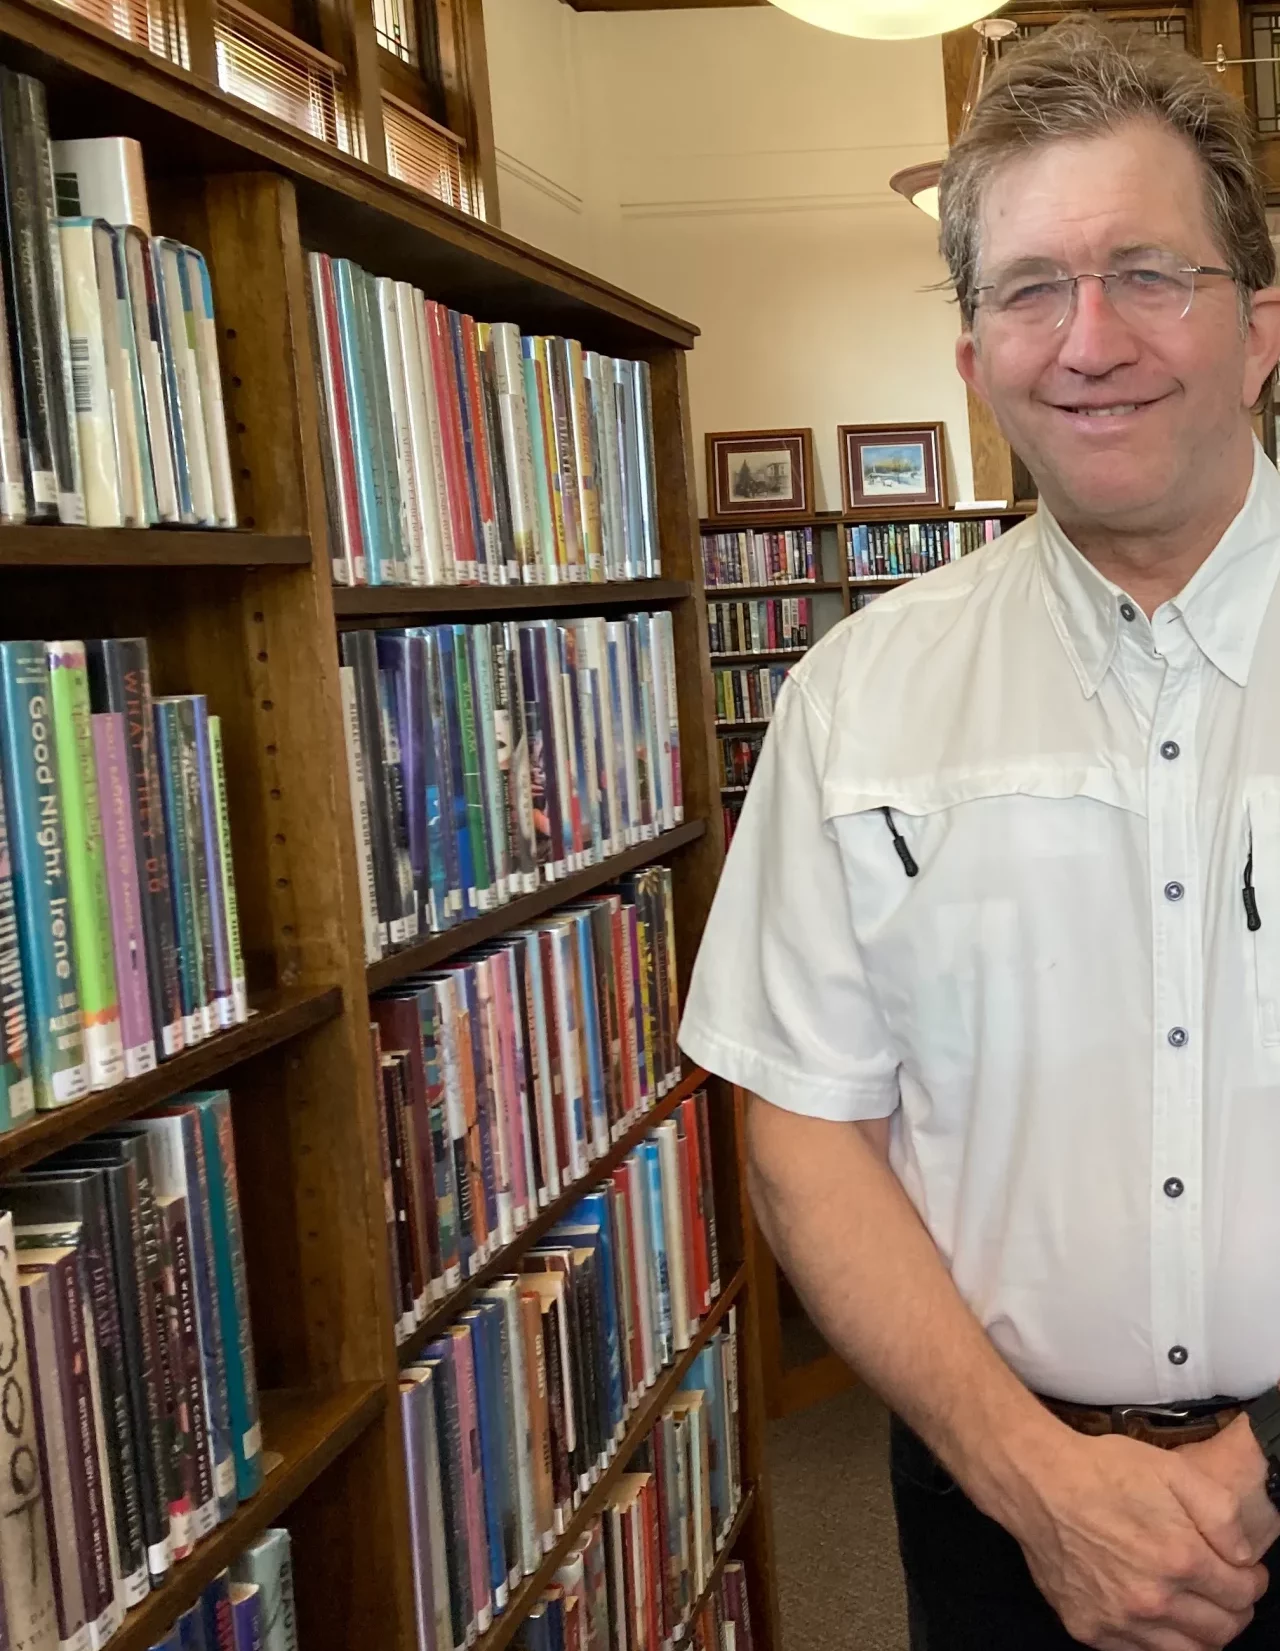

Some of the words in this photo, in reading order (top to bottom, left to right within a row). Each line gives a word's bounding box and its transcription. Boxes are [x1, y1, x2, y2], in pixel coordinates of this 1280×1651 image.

[463, 680, 475, 754] WICKHAM
[481, 660, 493, 722] WICKHAM
[122, 672, 146, 751] WHAT
[136, 771, 152, 838] THEY
[354, 752, 363, 783] BOYS
[27, 696, 53, 785] Good
[48, 897, 73, 980] Irene
[359, 801, 370, 847] COLSON
[136, 1178, 157, 1265] WALKER
[175, 1236, 188, 1273] ALICE
[180, 1281, 193, 1333] WALKER
[189, 1377, 199, 1400] THE
[192, 1405, 203, 1449] COLOR
